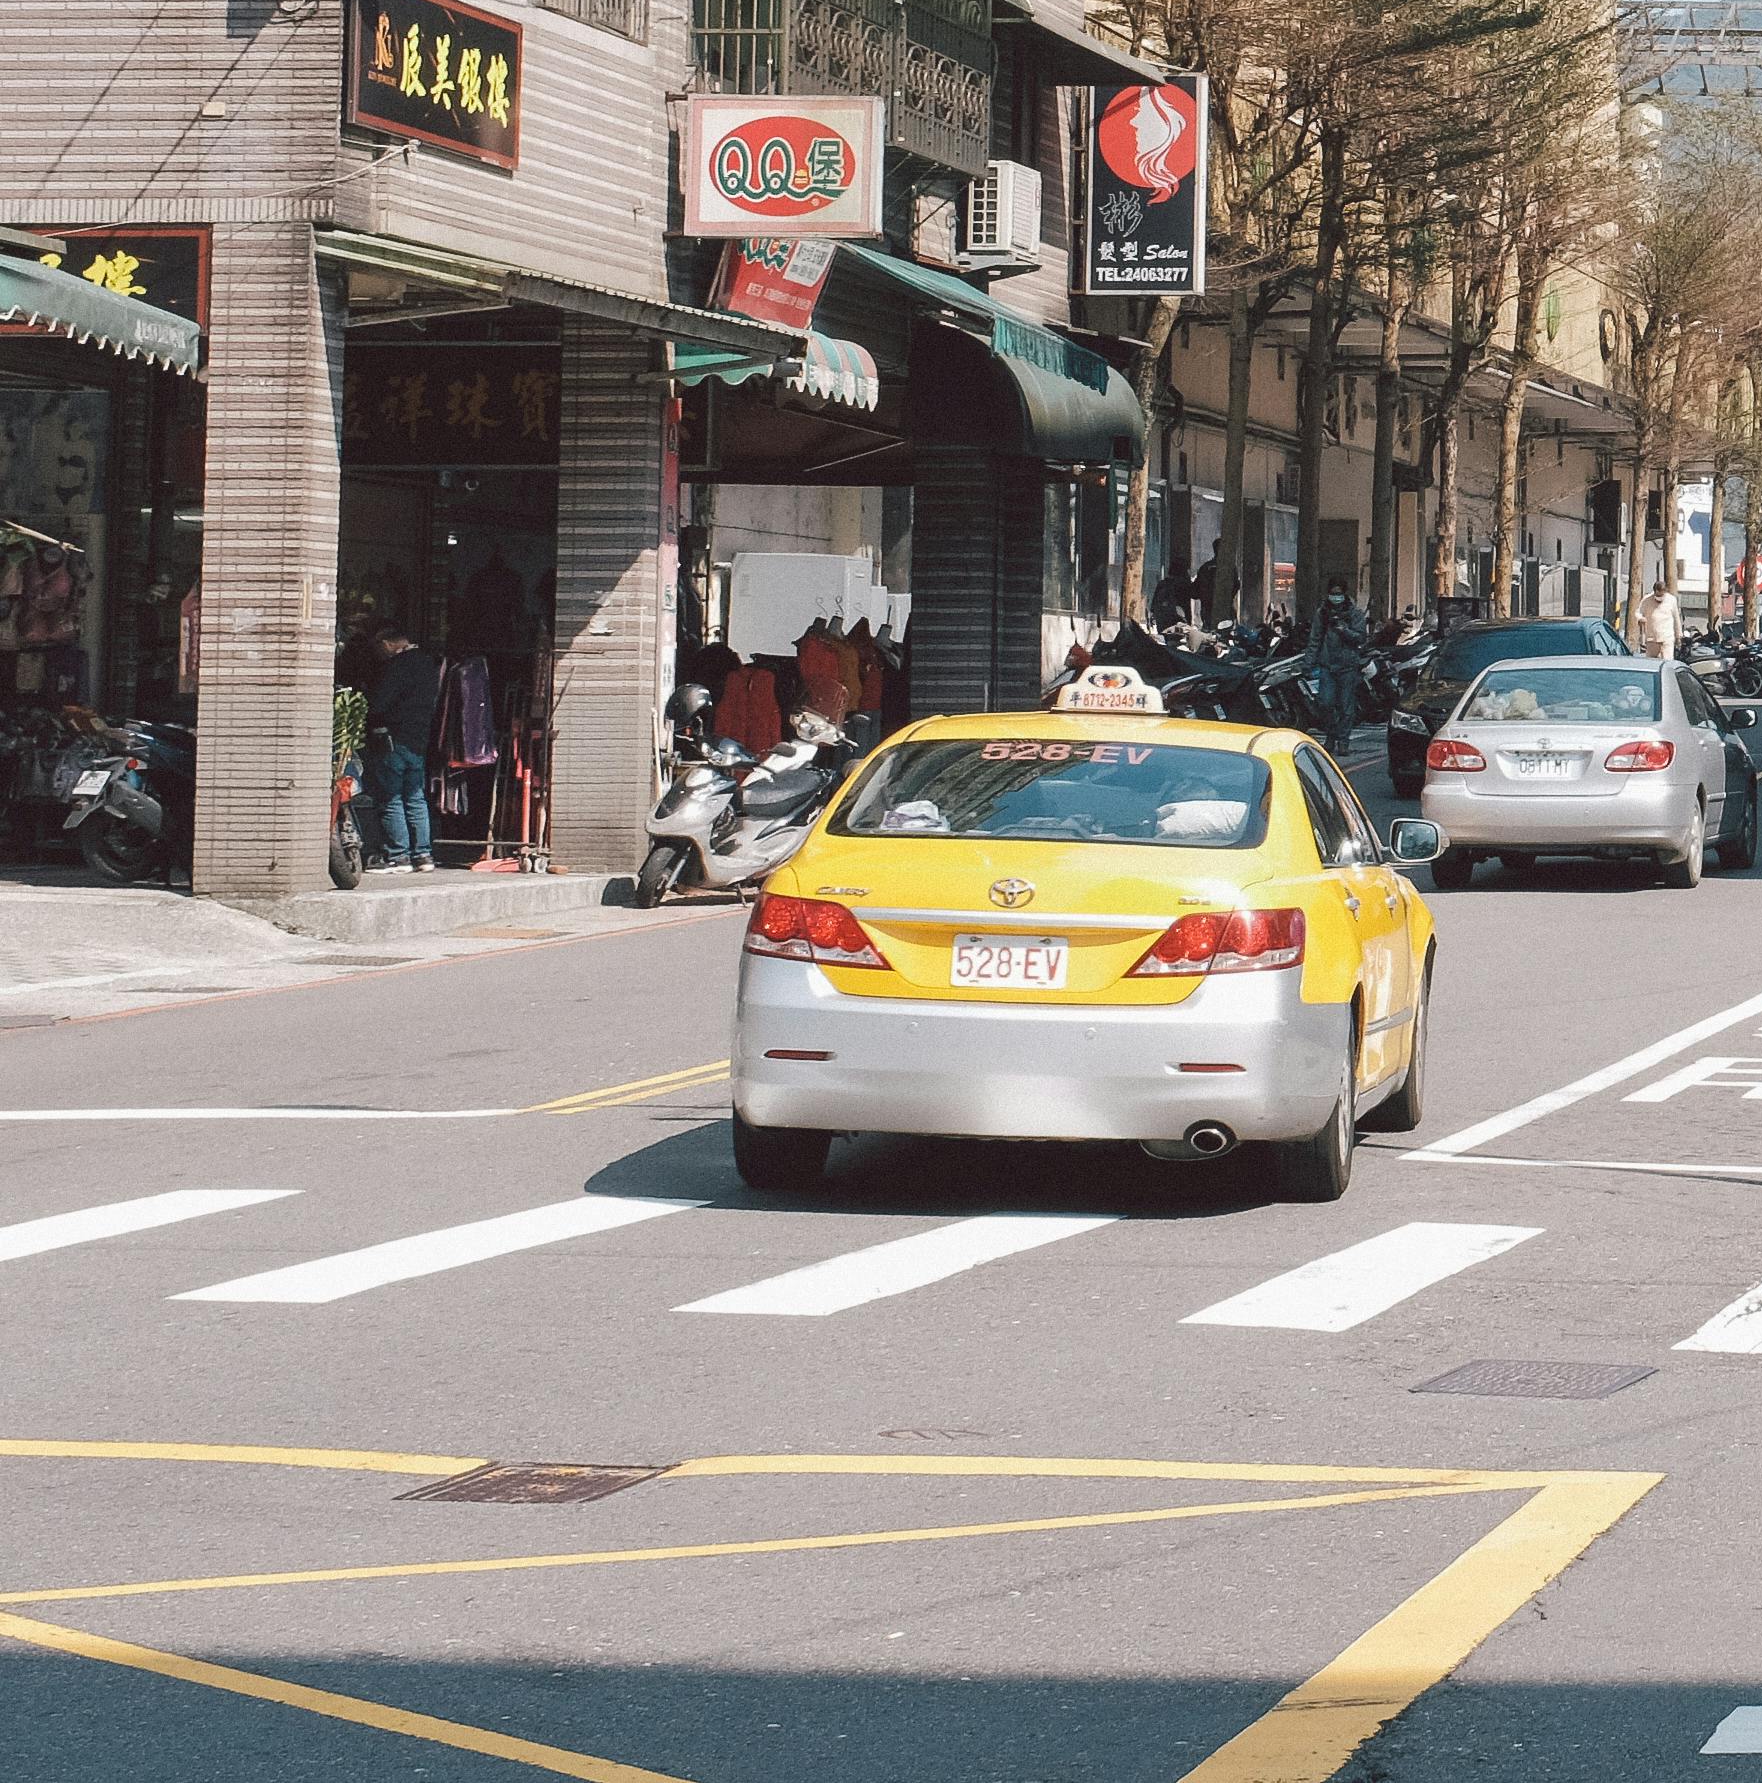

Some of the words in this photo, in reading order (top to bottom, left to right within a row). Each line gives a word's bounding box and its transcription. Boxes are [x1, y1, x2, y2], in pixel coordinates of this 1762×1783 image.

[716, 137, 850, 201] QQ堡
[1142, 244, 1189, 261] Salon
[981, 741, 1153, 766] 528-EV
[955, 945, 1062, 982] 528-EV
